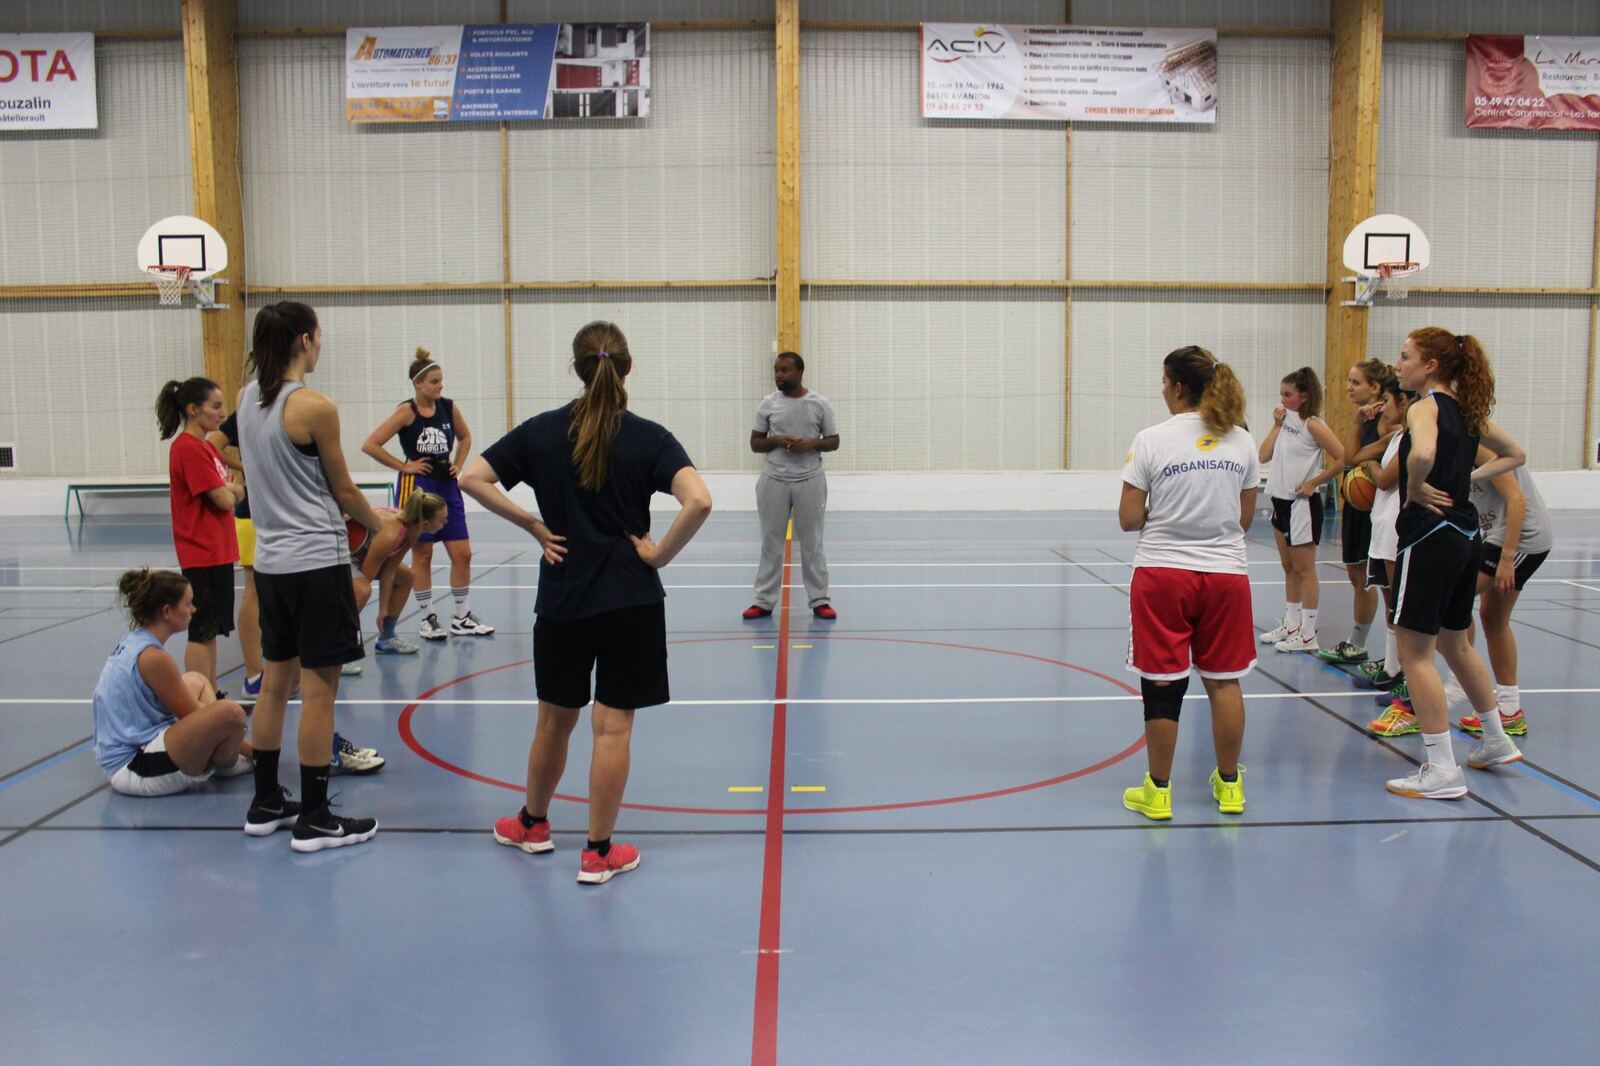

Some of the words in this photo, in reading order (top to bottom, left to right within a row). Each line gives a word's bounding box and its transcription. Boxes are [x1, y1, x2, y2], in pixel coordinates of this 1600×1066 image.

[927, 39, 1006, 53] ACIV
[1564, 50, 1600, 65] Mar
[1474, 97, 1486, 106] 05
[1489, 97, 1502, 106] 49
[1504, 98, 1516, 106] 47
[1532, 99, 1545, 108] 22
[1507, 109, 1563, 118] Commercial
[1163, 459, 1246, 477] ORGANISATION
